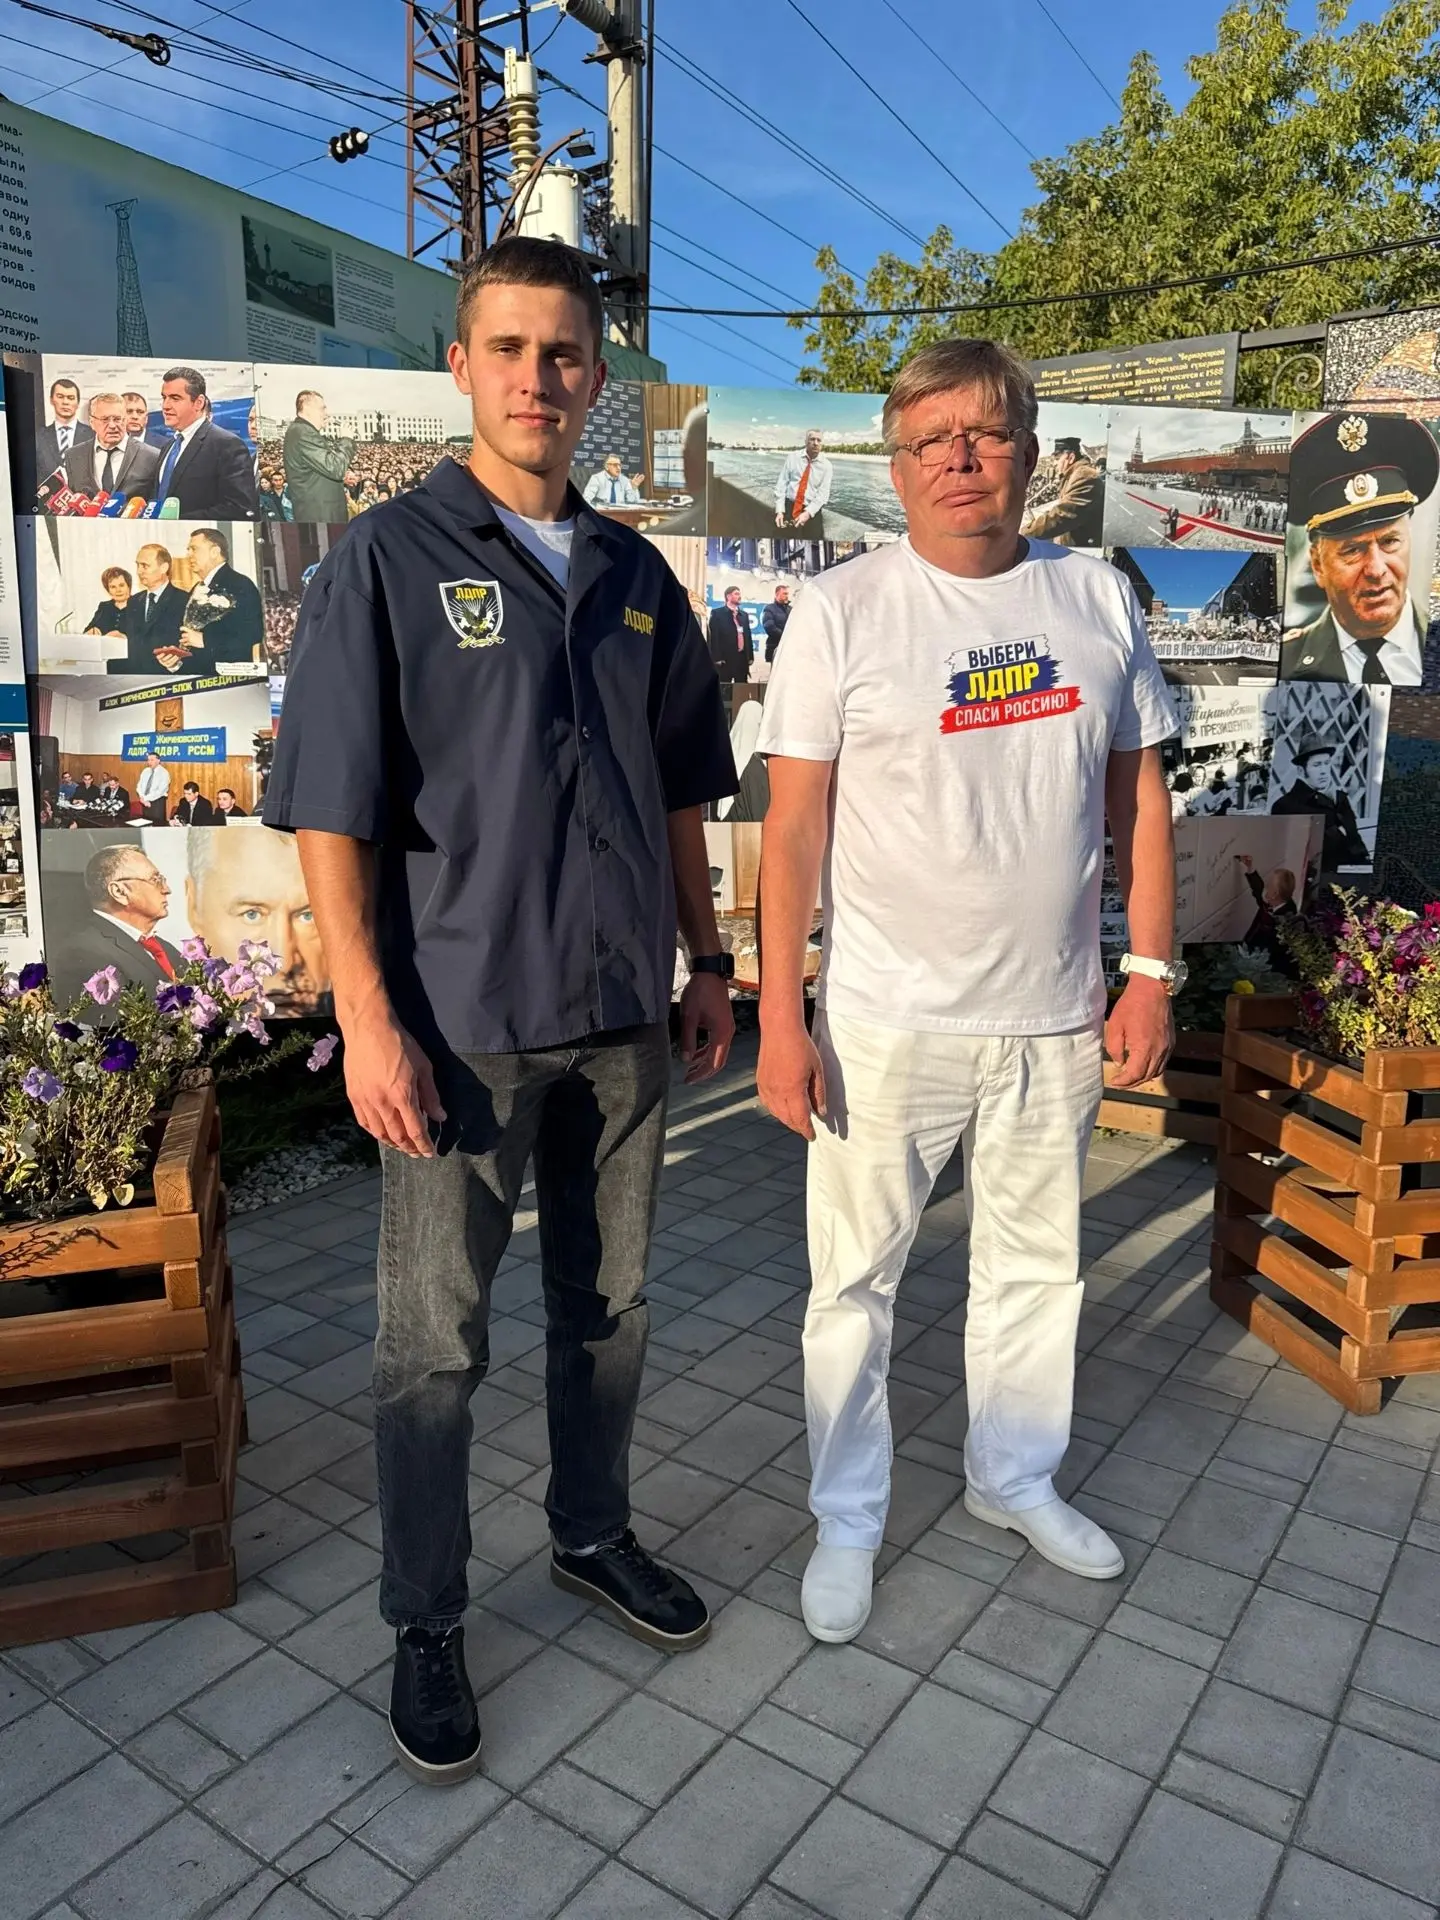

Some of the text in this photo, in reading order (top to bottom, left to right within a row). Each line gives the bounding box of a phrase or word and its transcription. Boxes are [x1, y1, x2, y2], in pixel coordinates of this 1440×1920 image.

[2, 208, 30, 226] одну
[9, 225, 32, 241] 69,6
[455, 587, 487, 600] ЛДПР
[623, 606, 653, 636] ЛДПР
[968, 640, 1037, 669] ВЫБЕРИ
[965, 661, 1039, 701] ЛДПР
[955, 691, 1069, 727] СПАСИ РОССИЮ!
[132, 736, 151, 745] БЛОК
[1189, 726, 1197, 738] В
[187, 745, 215, 756] РССМ
